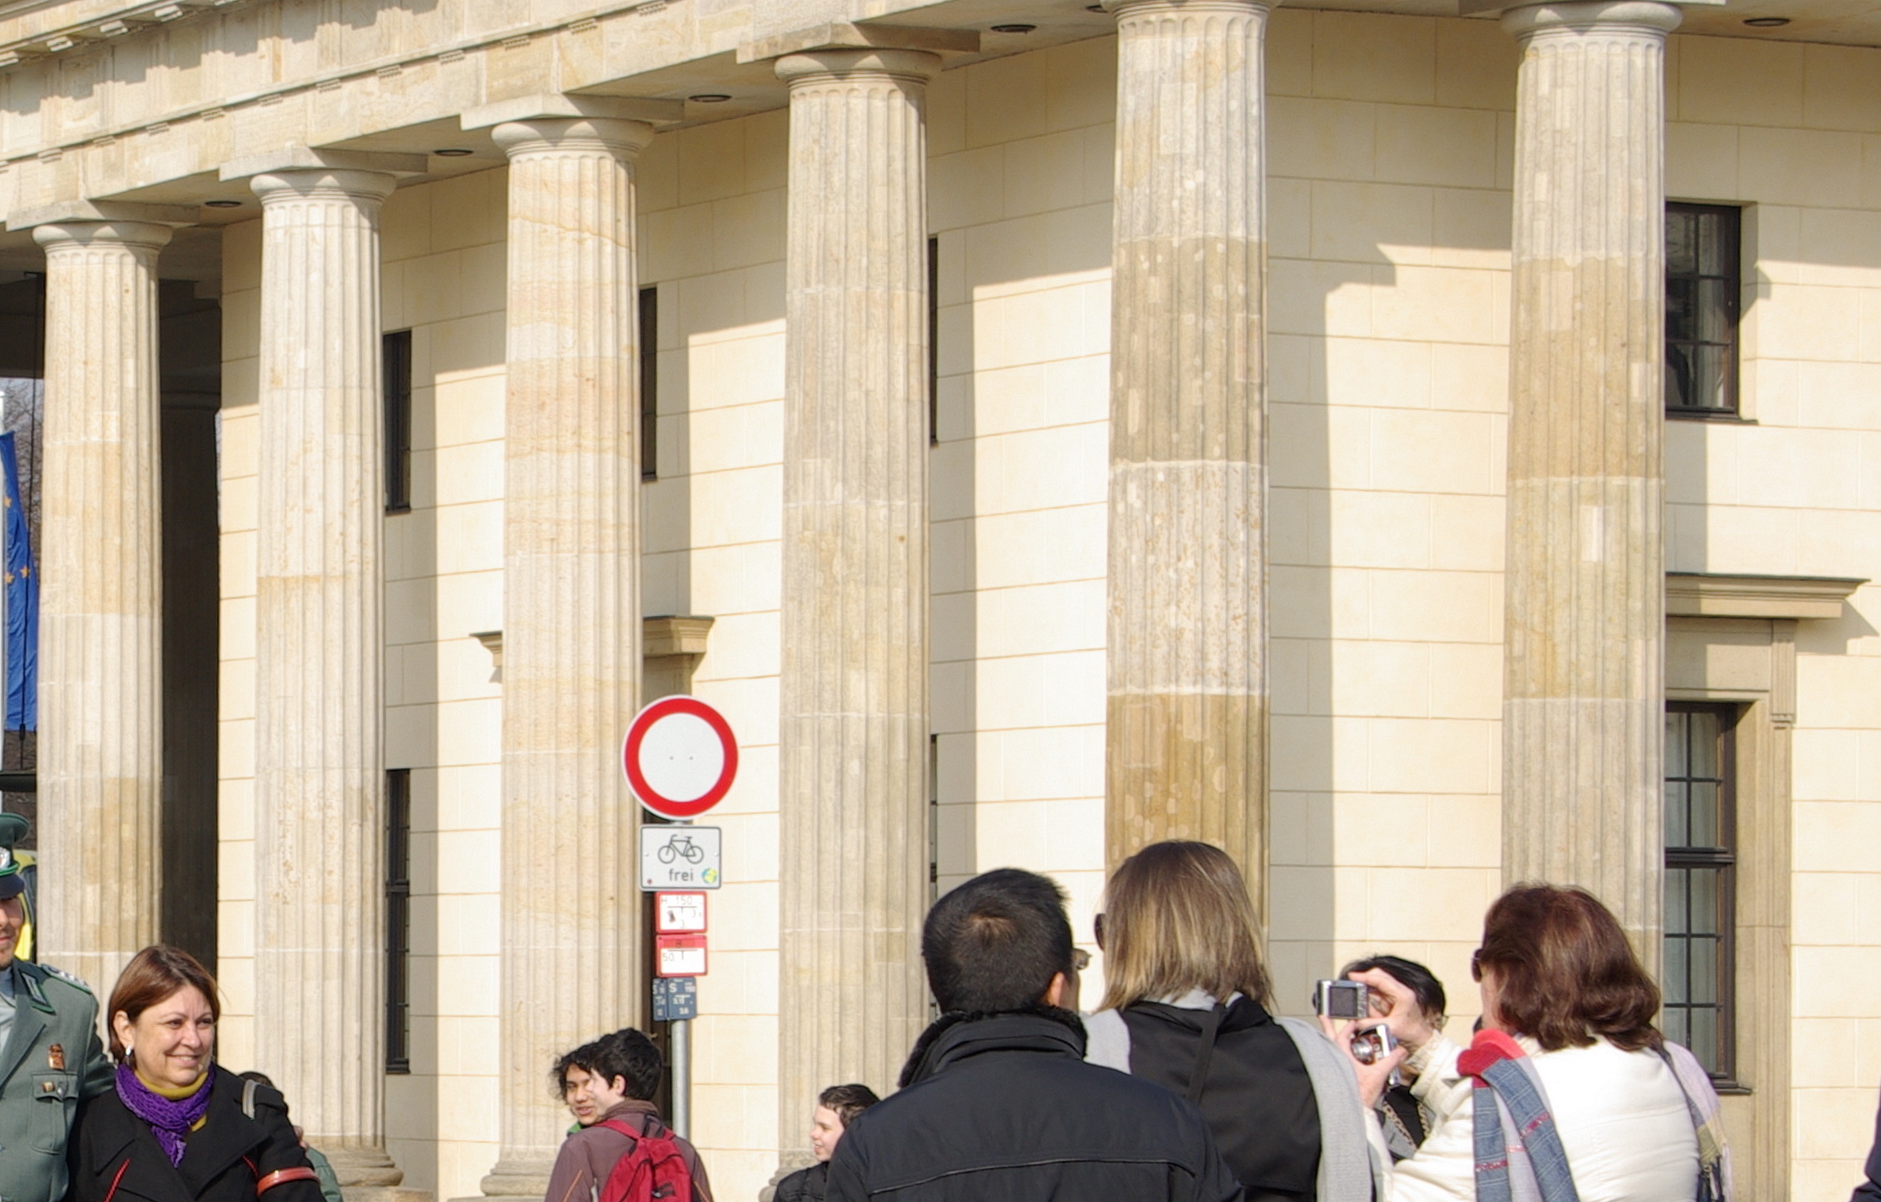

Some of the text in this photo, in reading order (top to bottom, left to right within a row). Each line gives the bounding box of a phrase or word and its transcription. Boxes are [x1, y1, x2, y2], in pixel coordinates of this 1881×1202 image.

[668, 868, 694, 882] frei
[675, 896, 693, 905] 150
[668, 982, 678, 993] S
